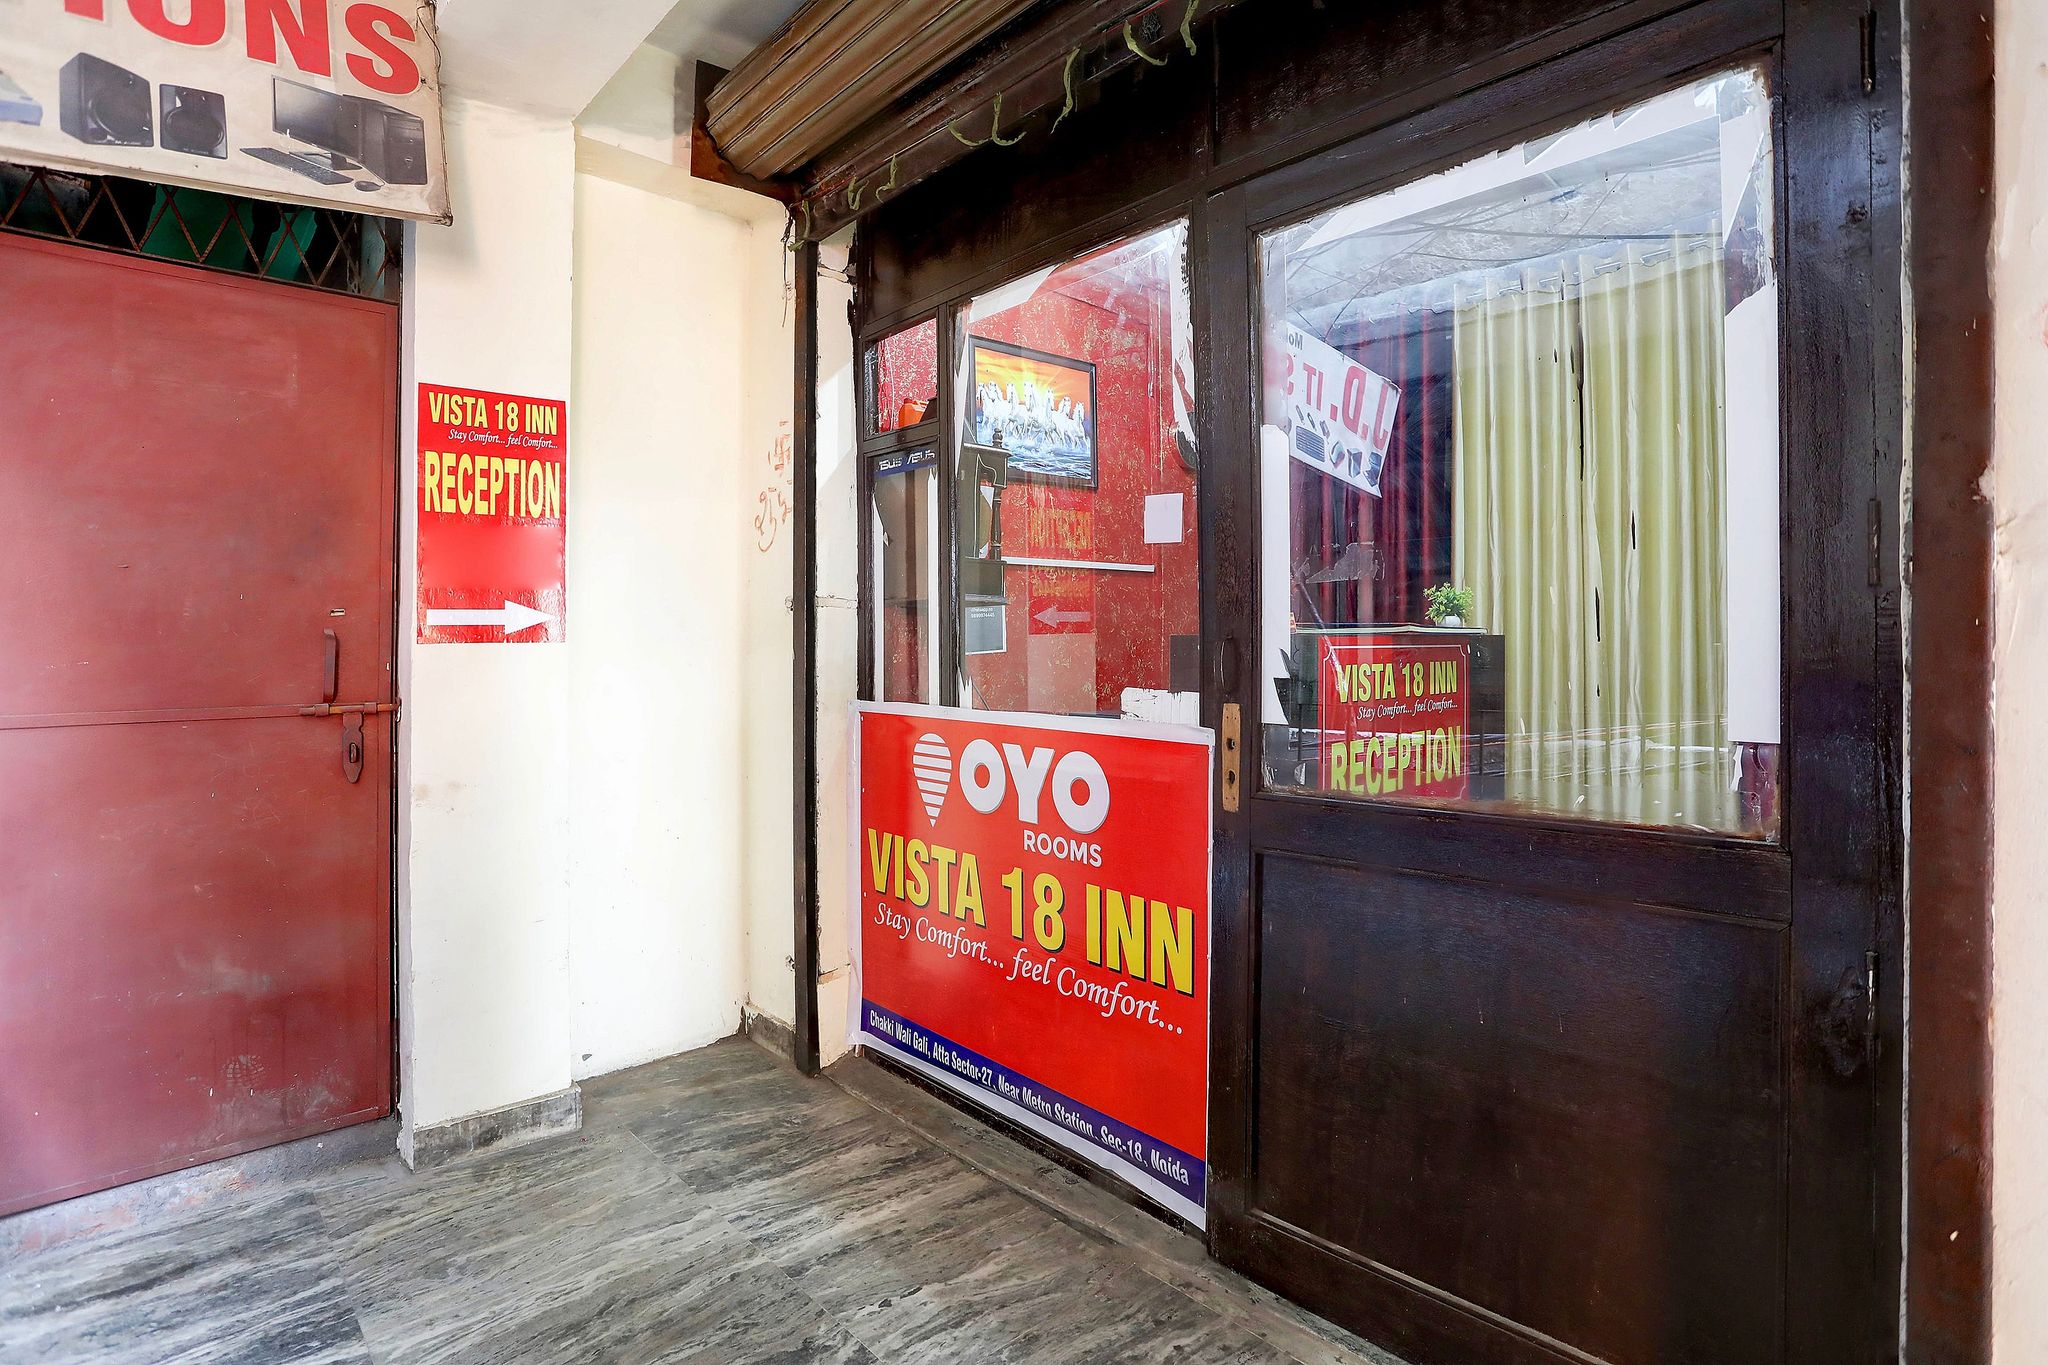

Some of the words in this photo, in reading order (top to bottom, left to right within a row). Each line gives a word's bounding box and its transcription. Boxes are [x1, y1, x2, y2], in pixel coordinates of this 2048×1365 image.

[64, 0, 421, 95] ONS
[428, 391, 488, 429] VISTA
[494, 401, 519, 432] 18
[525, 403, 558, 436] INN
[448, 428, 467, 443] Stay
[468, 431, 505, 446] Comfort...
[505, 434, 522, 448] feel
[522, 435, 558, 451] Comfort...
[424, 450, 560, 519] RECEPTION
[1338, 663, 1397, 703] VISTA
[1401, 661, 1425, 698] 18
[1429, 660, 1457, 695] INN
[1357, 705, 1376, 722] Stay
[1412, 698, 1428, 716] feel
[959, 738, 1110, 835] OYO
[1330, 724, 1462, 796] RECEPTION
[1023, 829, 1102, 868] ROOMS
[867, 828, 987, 929] VISTA
[1001, 867, 1065, 953] 18
[1085, 883, 1195, 998] INN
[874, 902, 911, 940] Stay
[915, 917, 1004, 969] Comfort...
[1006, 947, 1056, 984] feel
[1057, 966, 1183, 1035] Comfort...
[869, 1009, 894, 1037] Chakki
[895, 1021, 912, 1046] Wali
[913, 1031, 931, 1059] Gali,
[932, 1042, 950, 1066] Atta
[998, 1075, 1020, 1100] Near
[1022, 1086, 1052, 1116] Metro
[1151, 1149, 1190, 1186] Noida
